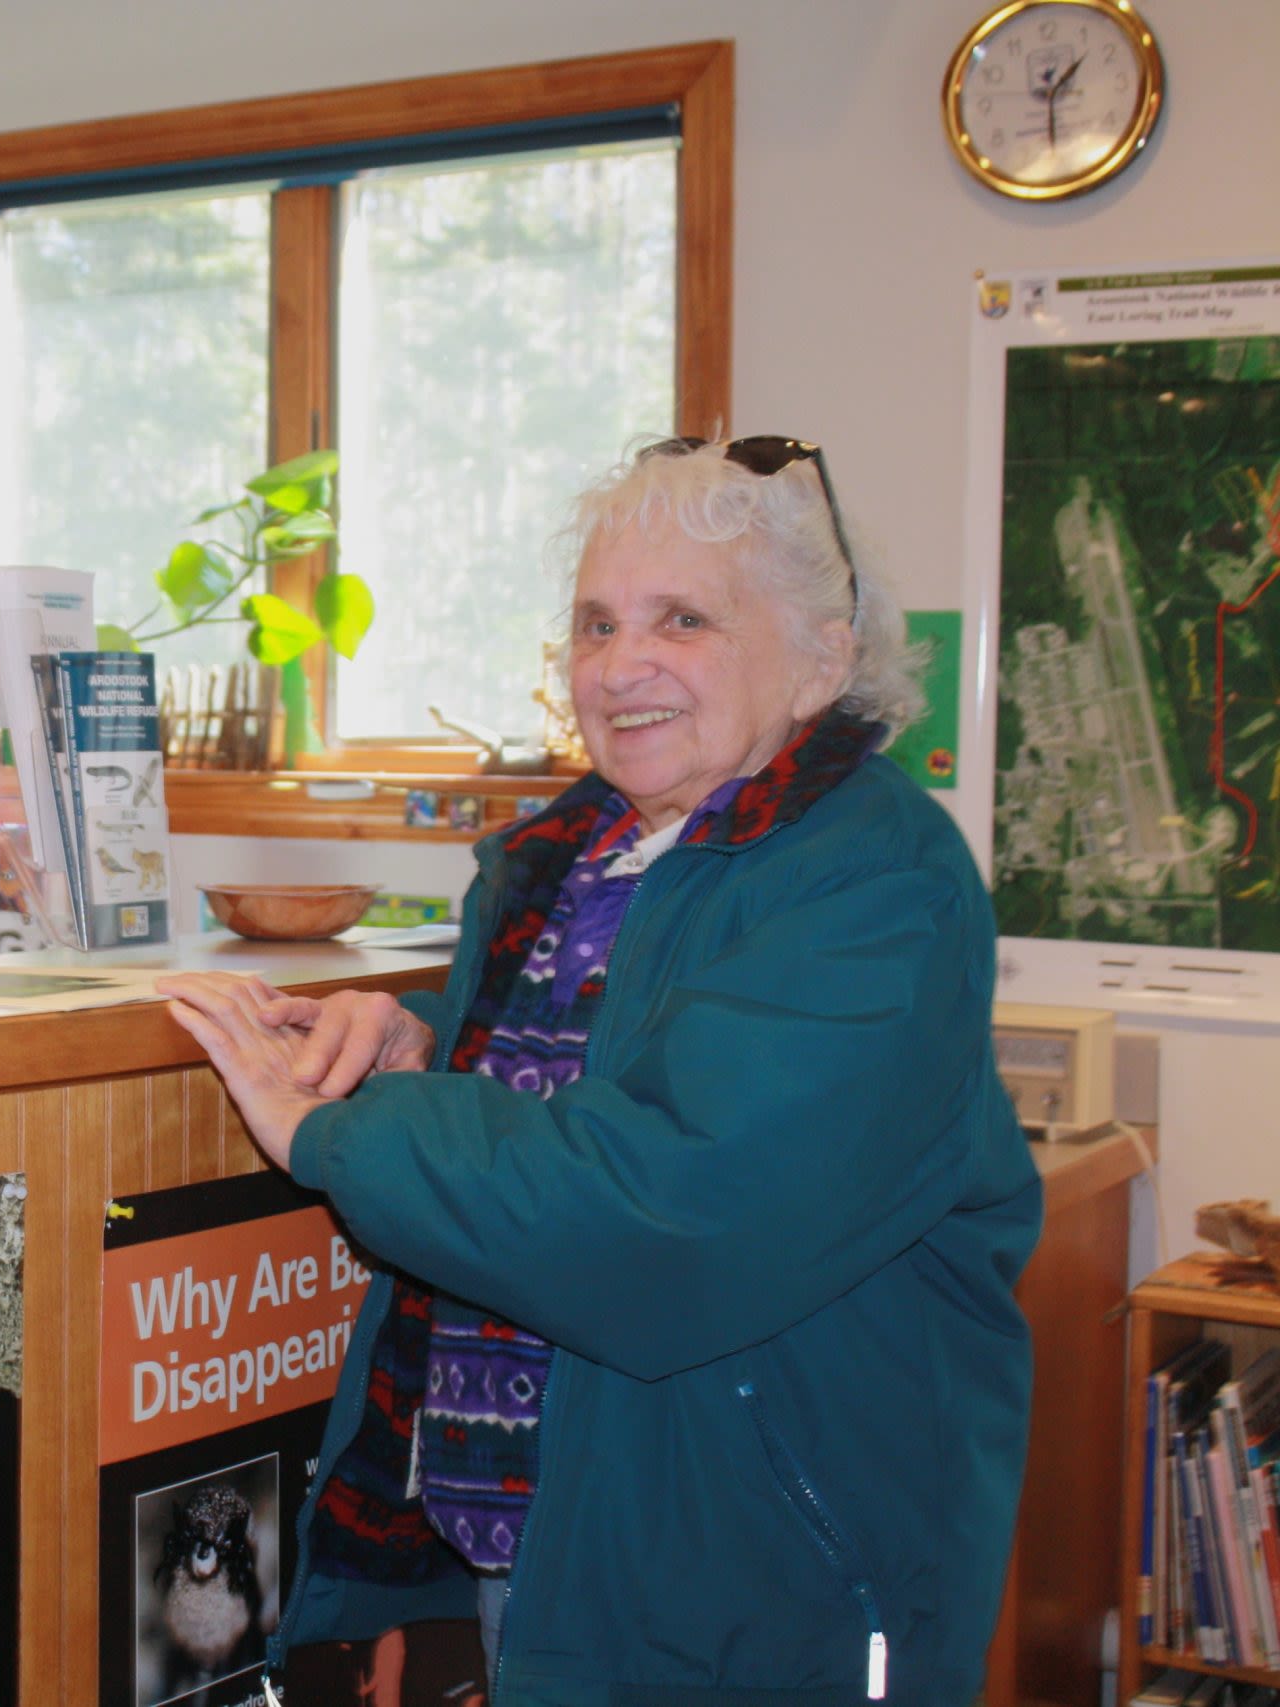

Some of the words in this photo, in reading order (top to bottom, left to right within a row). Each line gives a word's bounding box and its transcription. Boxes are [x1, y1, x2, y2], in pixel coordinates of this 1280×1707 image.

[88, 674, 148, 686] AROOSTOOK
[97, 690, 144, 702] NATIONAL
[79, 705, 125, 717] WILDLIFE
[127, 705, 159, 717] REFUGE
[131, 1266, 238, 1340] Why
[248, 1252, 318, 1313] Are
